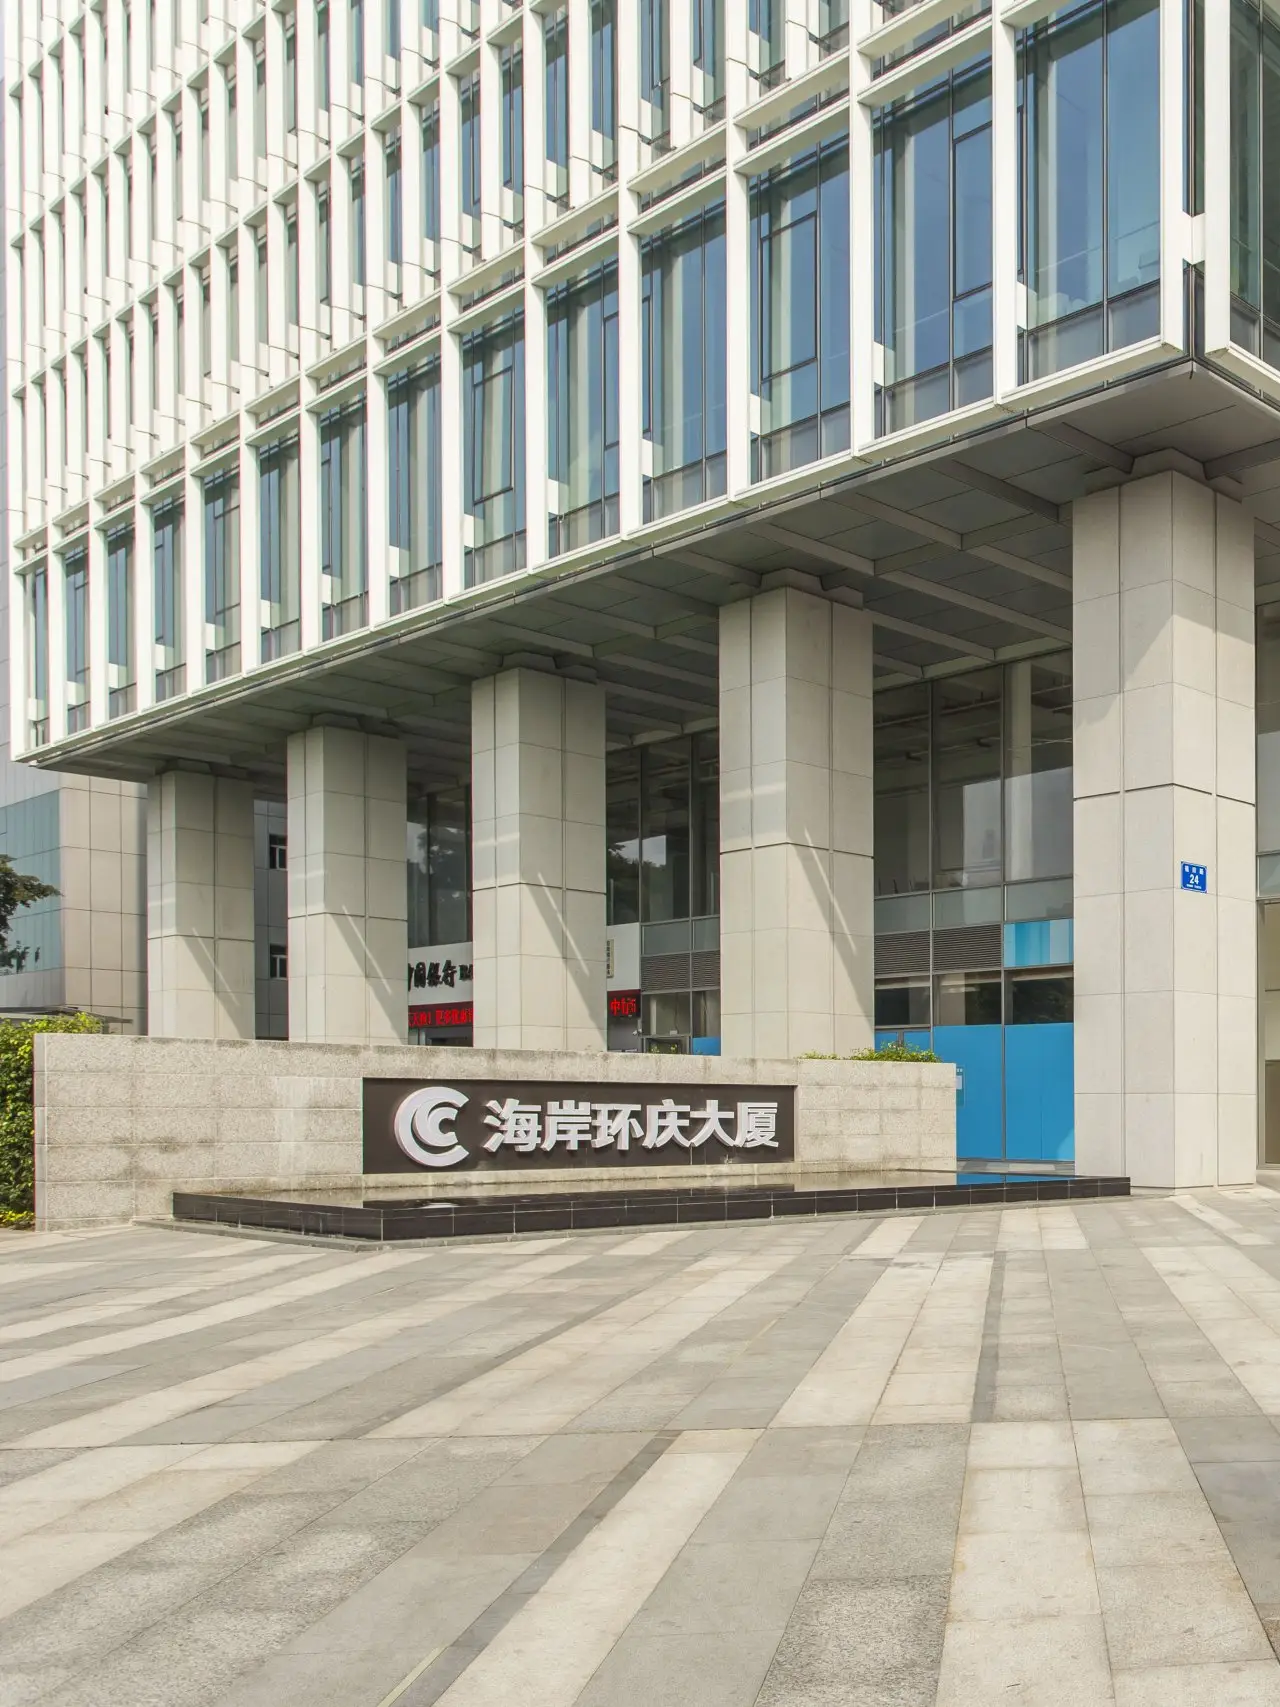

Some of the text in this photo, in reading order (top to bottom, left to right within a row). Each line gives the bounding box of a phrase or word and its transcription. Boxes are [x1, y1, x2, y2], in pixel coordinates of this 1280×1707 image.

[1189, 874, 1199, 885] 24
[482, 1098, 780, 1153] 海岸环庆大厦
